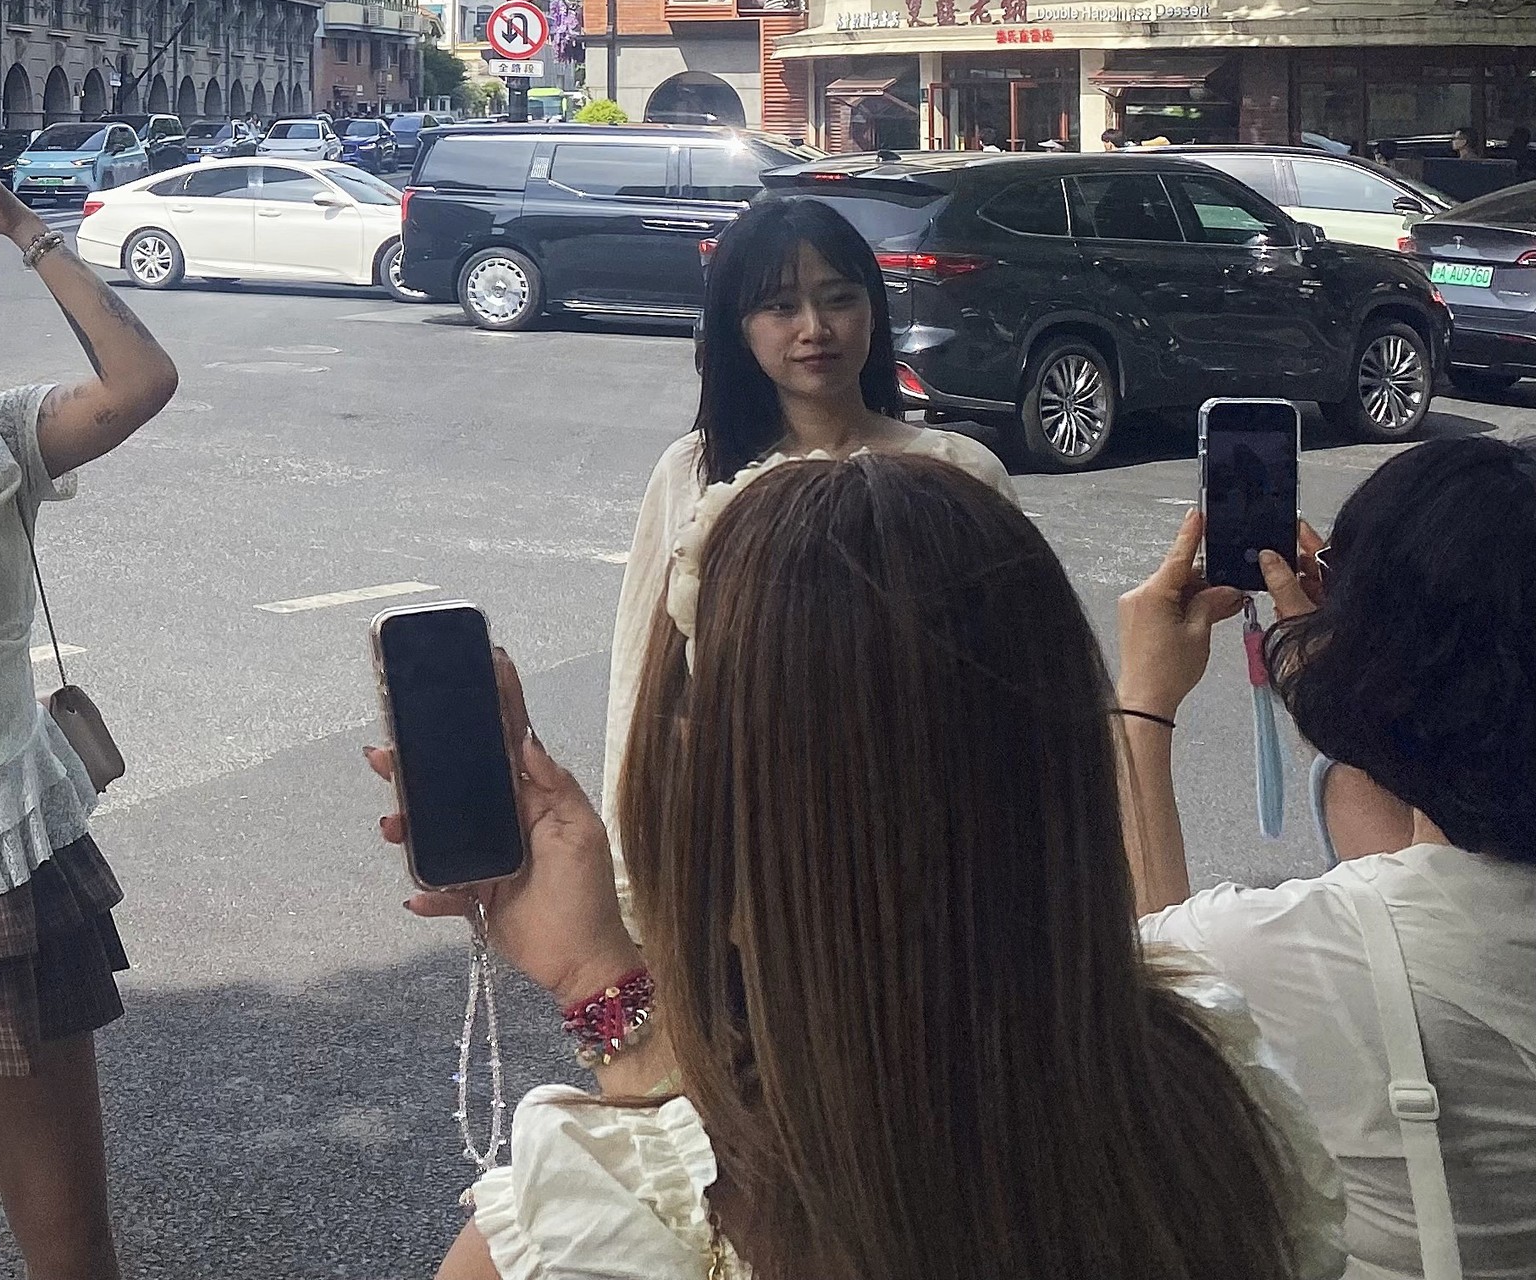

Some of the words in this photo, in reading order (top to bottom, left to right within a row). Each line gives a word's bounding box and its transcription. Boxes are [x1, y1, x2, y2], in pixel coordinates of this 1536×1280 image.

[1036, 6, 1079, 20] Double
[1155, 3, 1210, 18] Dessert
[498, 63, 534, 74] 全路段
